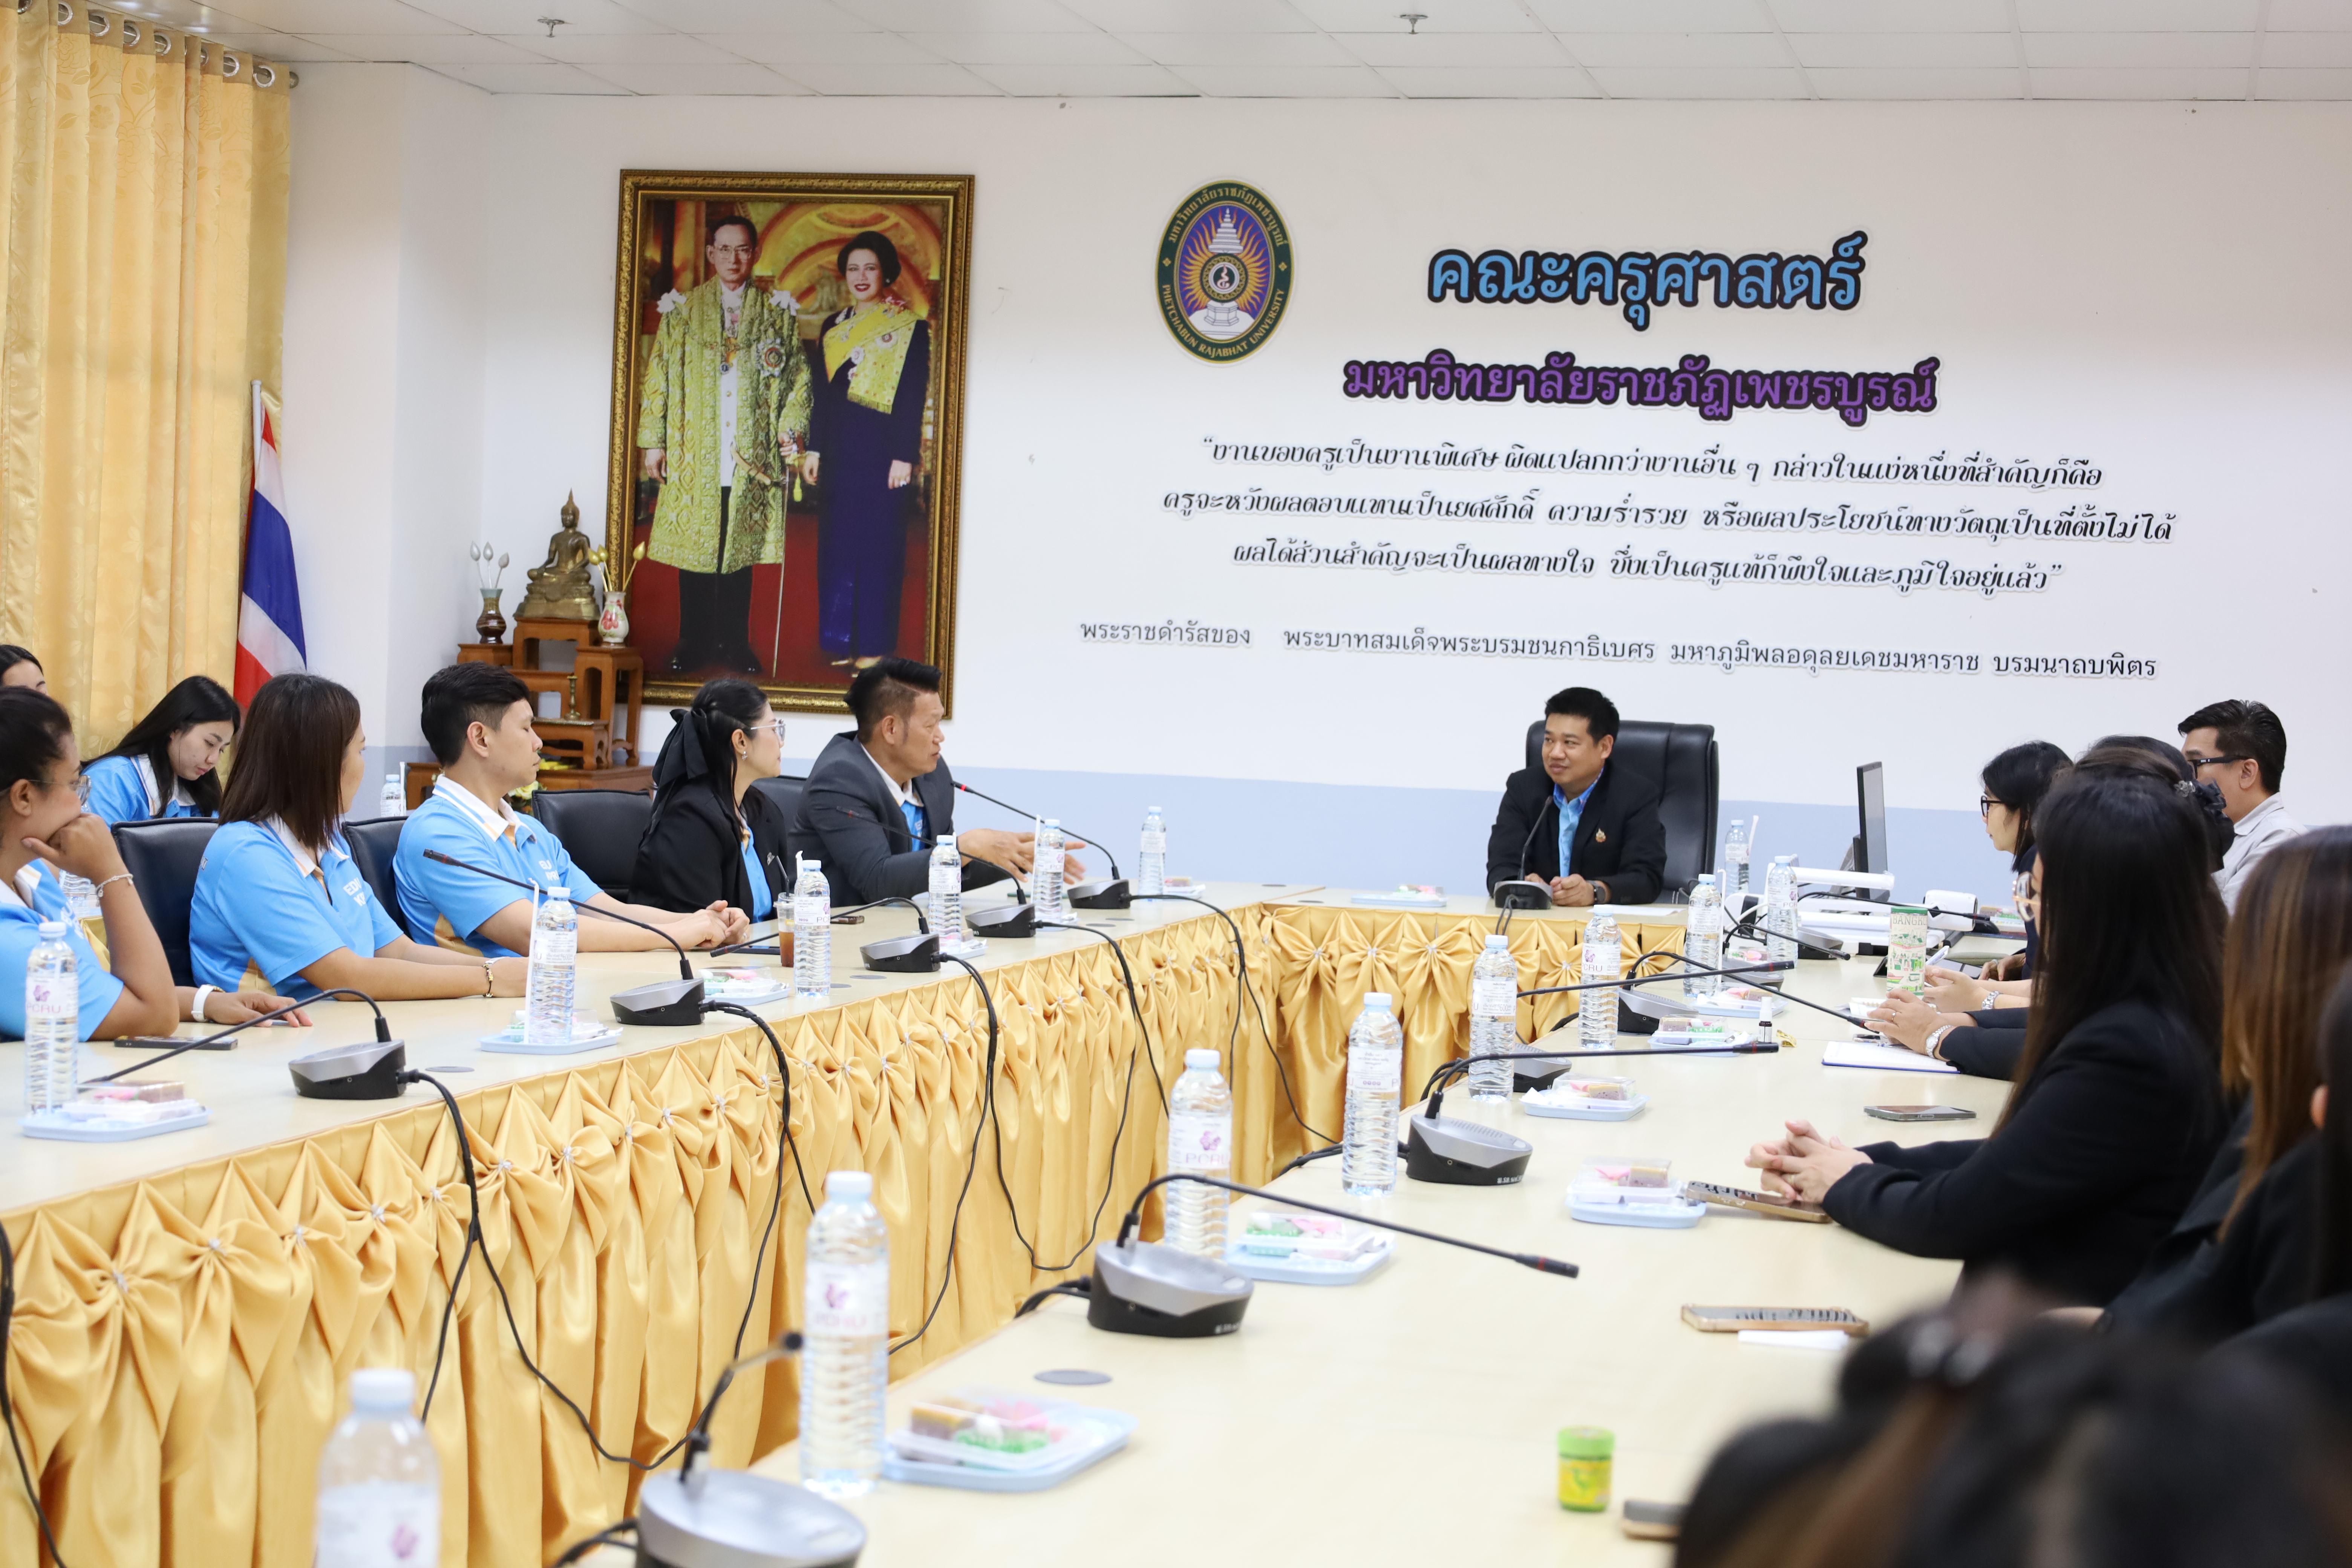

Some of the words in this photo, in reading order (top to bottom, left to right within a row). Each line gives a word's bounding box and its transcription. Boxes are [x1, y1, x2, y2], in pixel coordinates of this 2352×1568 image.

[1168, 187, 1288, 247] มหาวิทยาลัยราชภัฏเพชรบูรณ์
[1428, 231, 1868, 331] คณะครุศาสตร์
[1162, 284, 1199, 348] PHETCHABUN
[1198, 341, 1249, 358] RAJABHAT
[1249, 288, 1285, 344] UNIVERSITY
[1343, 349, 1940, 427] มหาวิทยาลัยราชภัฏเพชรบูรณ์
[1774, 450, 2102, 488] กล่าวในแง่หนึ่งที่สำคัญก็คือ
[1164, 488, 1539, 519] ครูจะหวังผลตอบแทนเป็นยศศักดิ์
[1549, 493, 1687, 524] ความร่ำรวย
[1234, 538, 1594, 573] ผลได้ส่วนสำคัญจะเป็นผลทางใจ
[1081, 621, 1249, 643] พระราชดำรัสของ
[1285, 628, 1654, 658] พระบาทสมเด็จพระบรมชนกาธิเบศร
[1672, 640, 1978, 672] มหาภูมิพลอดุลยเดชมหาราช
[1994, 652, 2156, 675] บรมนาถบพิตร
[1893, 915, 1927, 926] BANGKO
